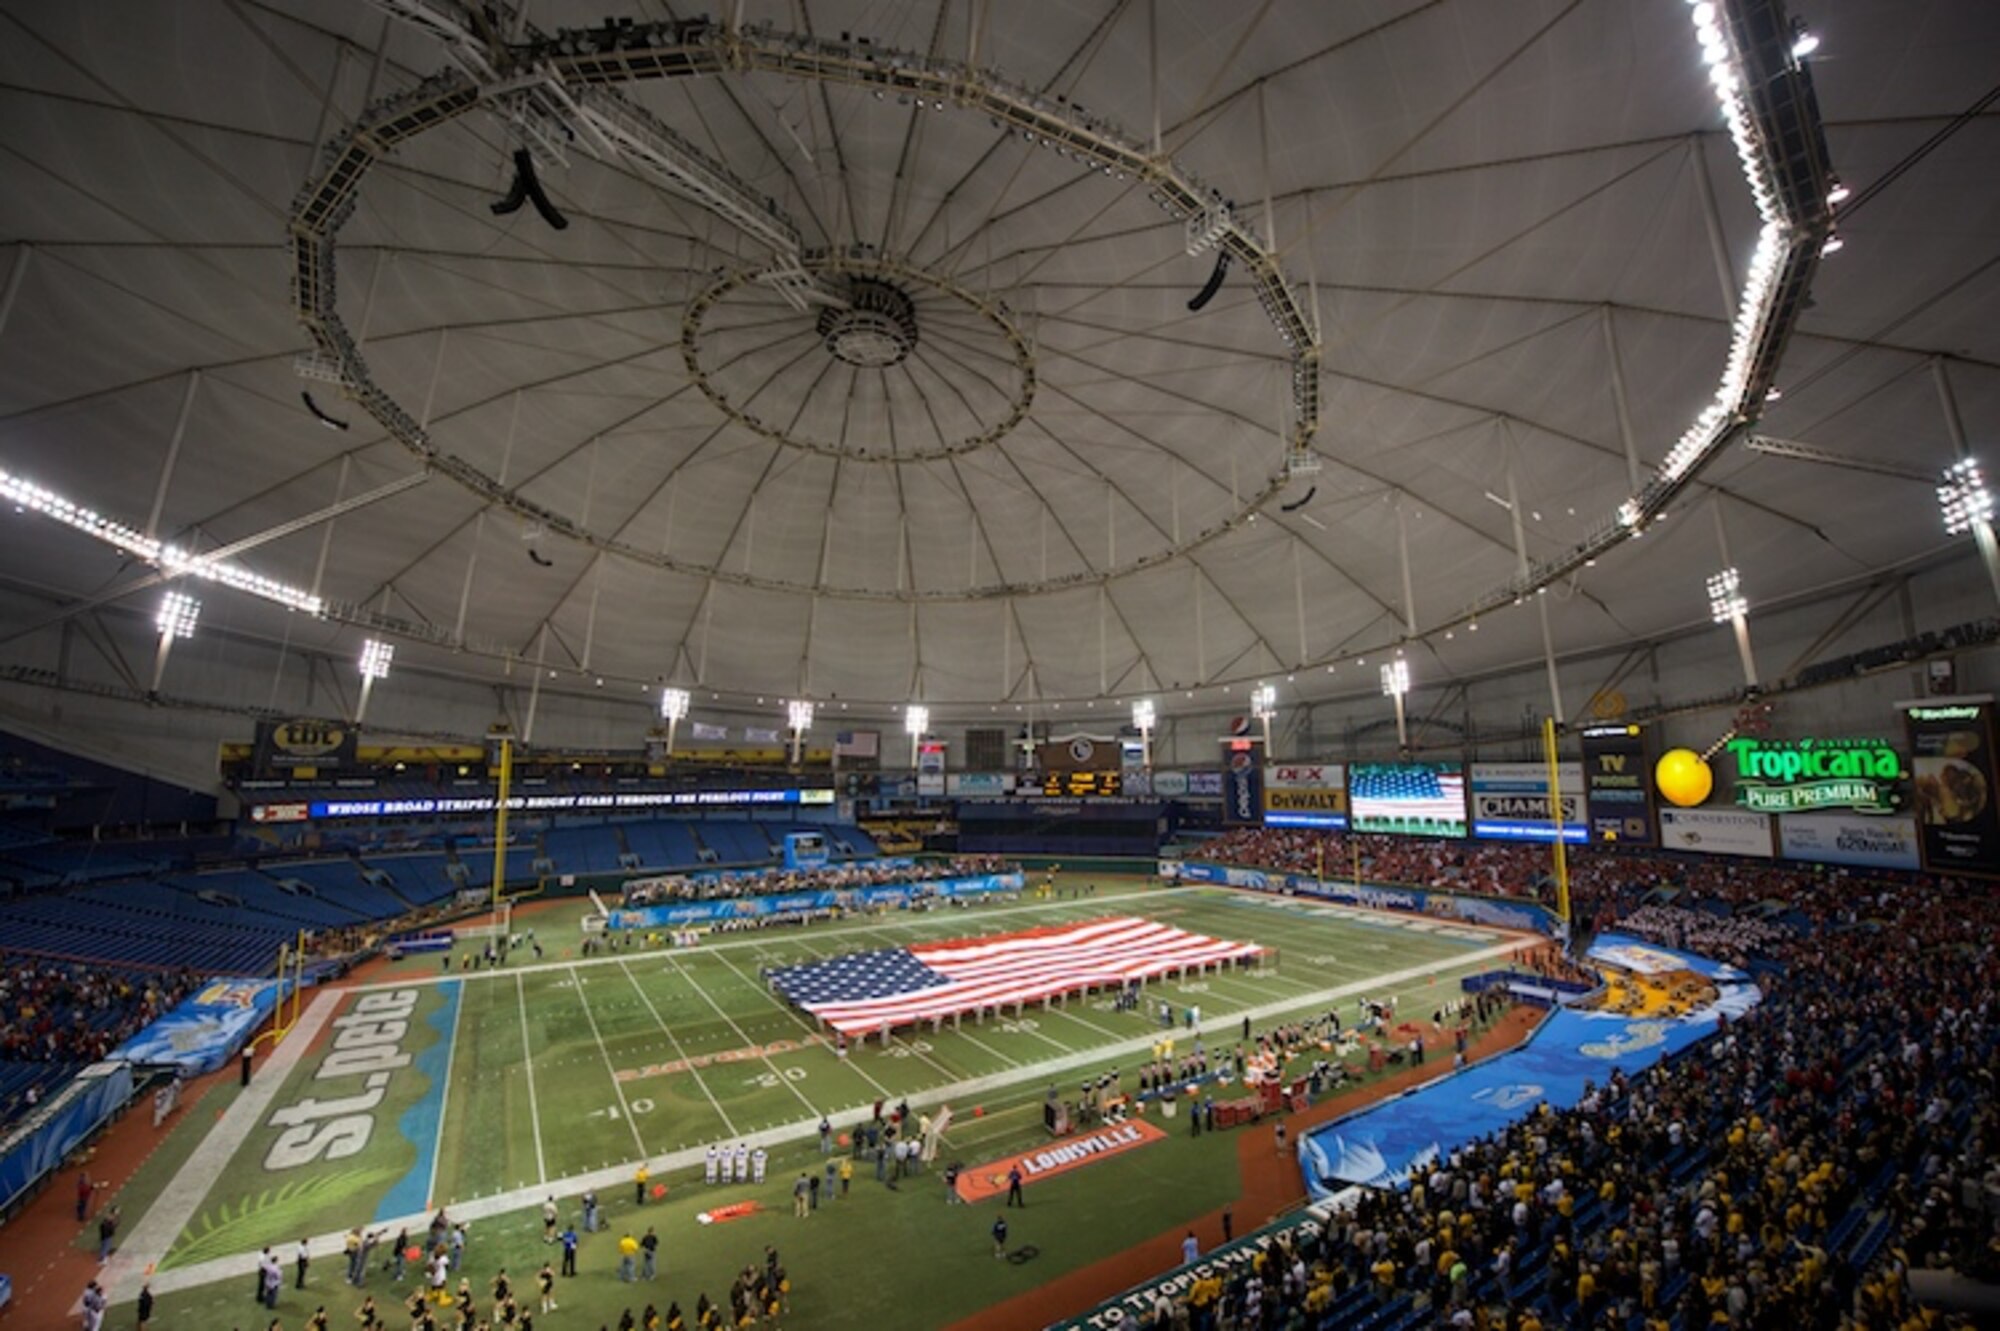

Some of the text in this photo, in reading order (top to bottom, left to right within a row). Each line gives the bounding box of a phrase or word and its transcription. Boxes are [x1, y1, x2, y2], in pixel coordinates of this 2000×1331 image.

[1600, 754, 1626, 772] TV
[1727, 737, 1899, 783] Tropicana
[327, 802, 381, 815] WHOSE
[383, 800, 435, 814] BROAD
[436, 799, 493, 812] STRIPES
[1748, 785, 1877, 807] PURE PREMIUM
[1021, 1124, 1144, 1175] LOUISVILLE
[1087, 1305, 1124, 1330] TO
